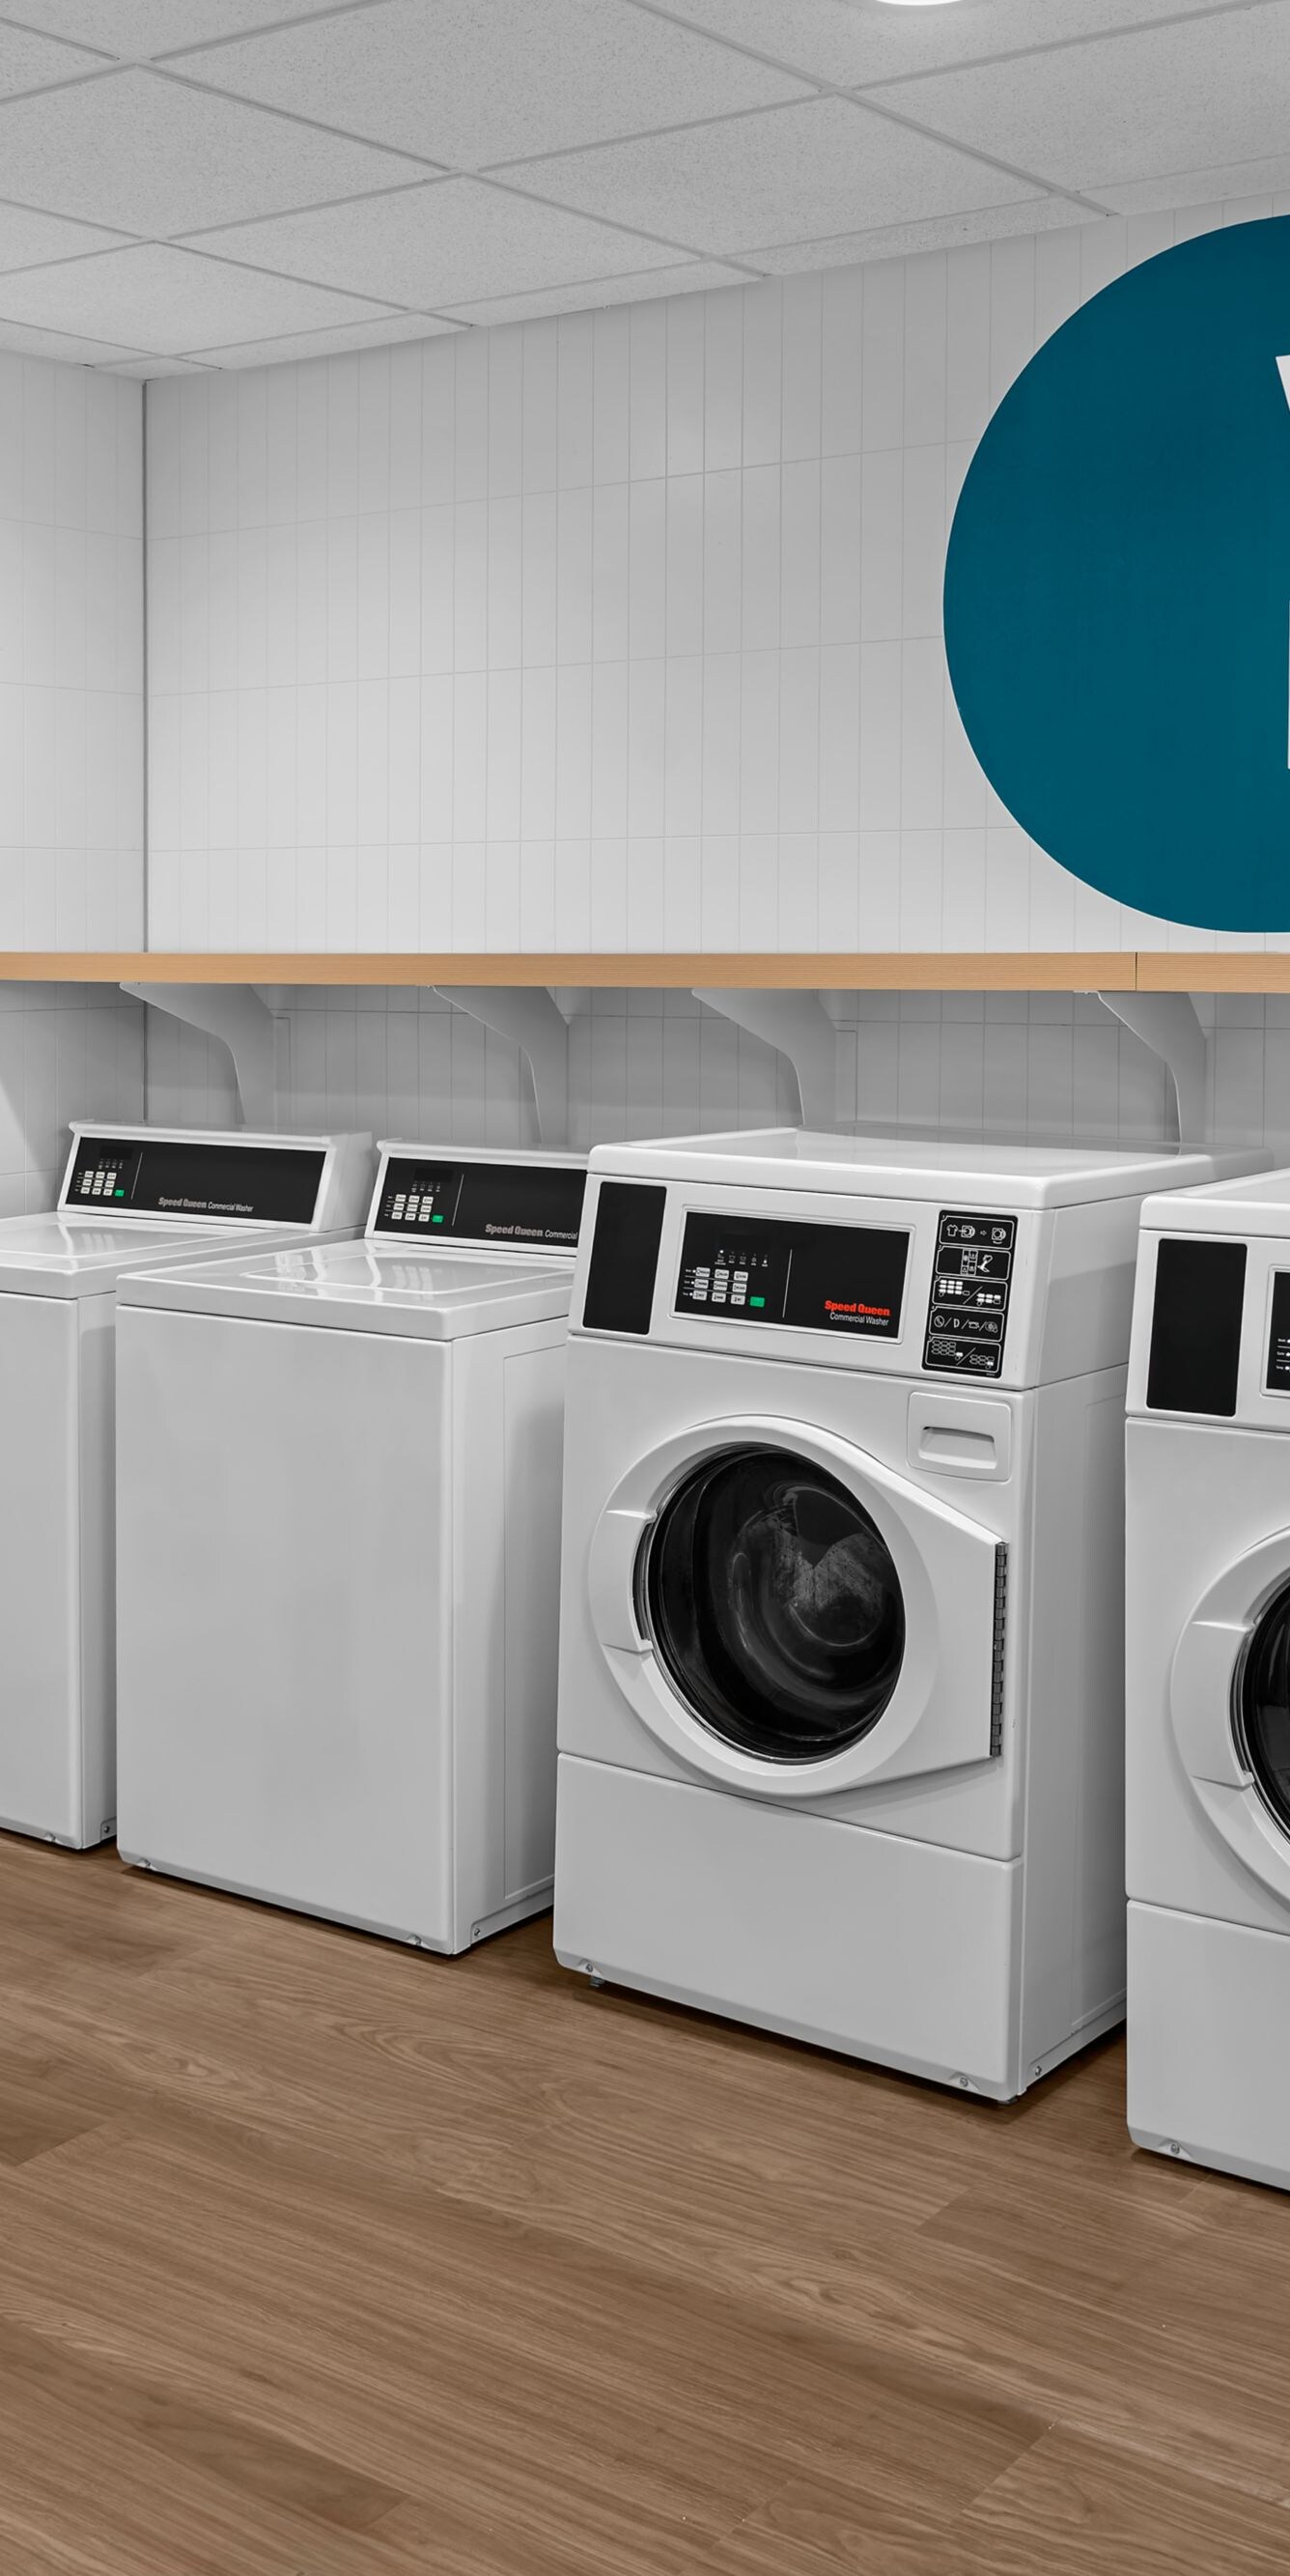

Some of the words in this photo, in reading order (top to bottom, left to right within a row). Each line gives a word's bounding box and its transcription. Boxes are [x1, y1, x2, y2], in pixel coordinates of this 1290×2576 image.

[157, 1197, 182, 1207] Speed
[182, 1199, 207, 1208] Queen
[208, 1202, 235, 1211] Commercial
[236, 1203, 254, 1212] Washer
[485, 1224, 514, 1234] Speed
[514, 1226, 543, 1236] Queen
[545, 1230, 577, 1239] Commercial
[825, 1300, 856, 1312] Speed
[857, 1303, 890, 1316] Queen
[829, 1312, 865, 1323] Commercial
[865, 1316, 889, 1326] Washer
